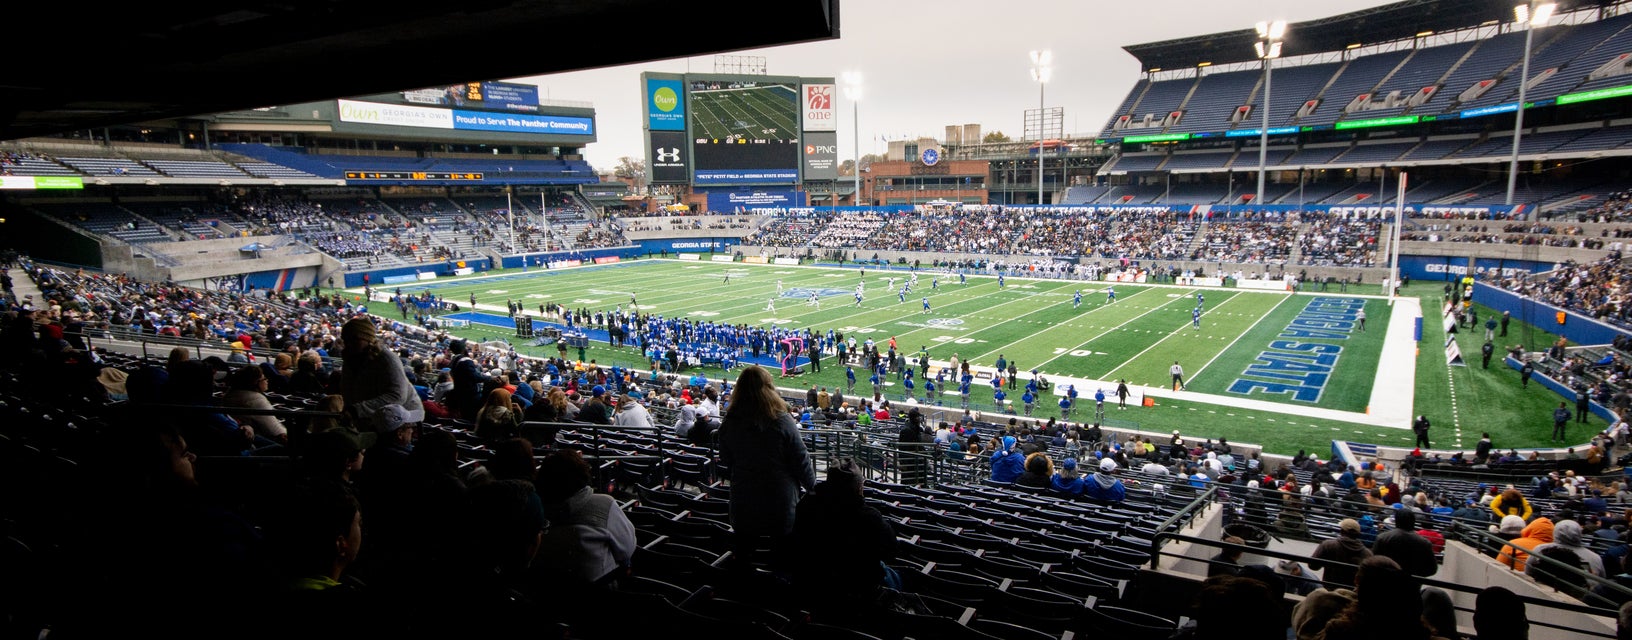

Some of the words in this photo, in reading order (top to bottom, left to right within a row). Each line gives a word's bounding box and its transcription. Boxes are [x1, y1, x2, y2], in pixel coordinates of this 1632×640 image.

[655, 95, 675, 104] Own
[456, 116, 476, 124] Proud
[487, 117, 506, 125] Serve
[550, 121, 588, 131] Community
[816, 146, 836, 154] PNC
[1277, 296, 1369, 339] GEORGIA
[1052, 347, 1092, 357] 10
[1225, 340, 1344, 403] STATE
